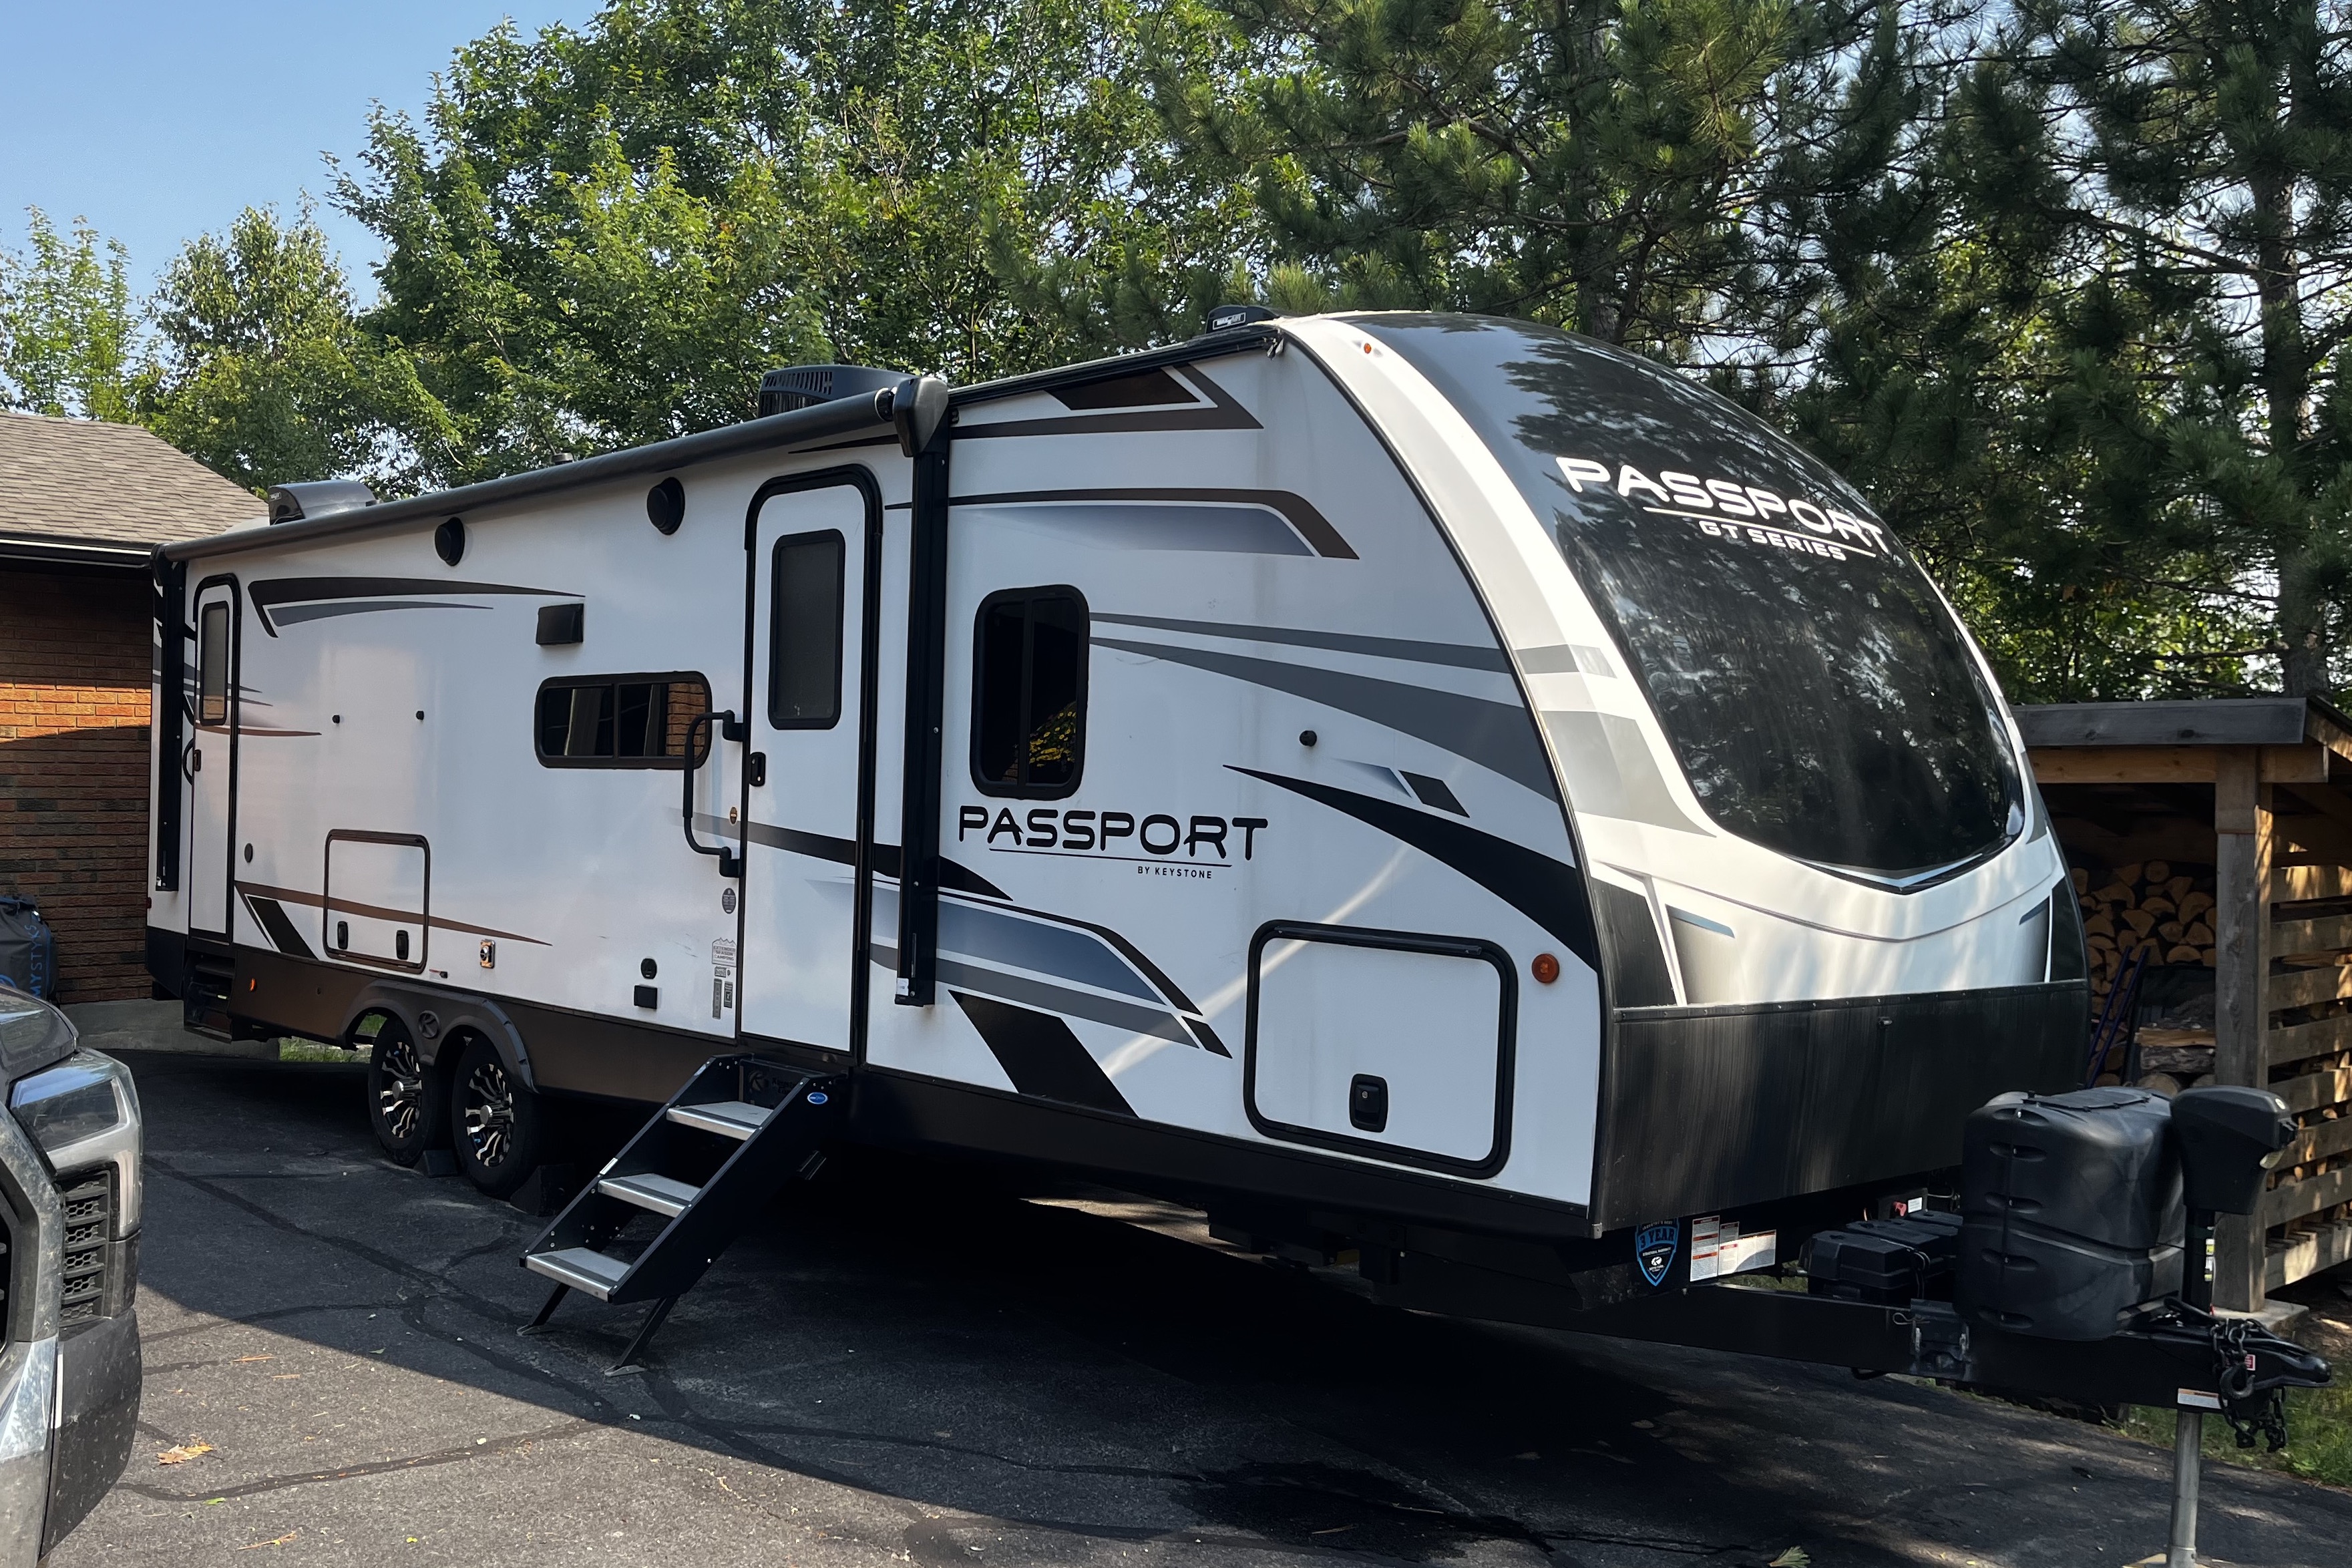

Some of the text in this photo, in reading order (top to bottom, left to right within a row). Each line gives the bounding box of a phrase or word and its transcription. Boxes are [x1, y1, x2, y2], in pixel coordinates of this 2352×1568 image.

[1555, 456, 1889, 554] PASSPORT
[1699, 520, 1846, 561] GT SERIES
[958, 805, 1269, 861] PASSPORT
[1137, 866, 1213, 879] BY KEYSTONE
[1639, 1228, 1675, 1249] 3 YEAR
